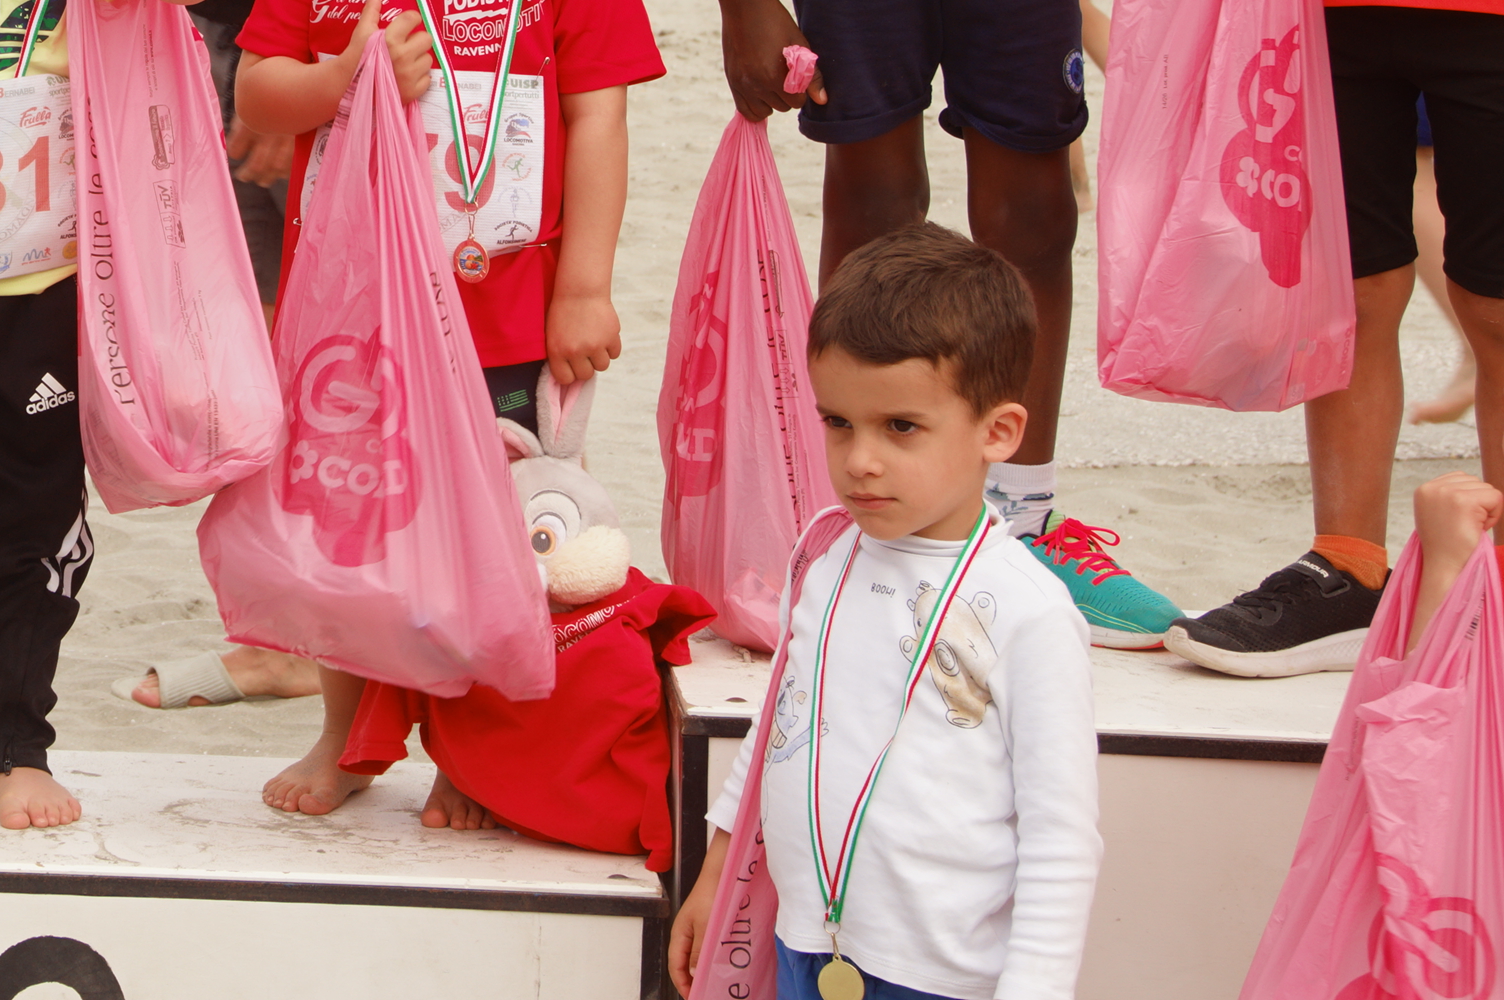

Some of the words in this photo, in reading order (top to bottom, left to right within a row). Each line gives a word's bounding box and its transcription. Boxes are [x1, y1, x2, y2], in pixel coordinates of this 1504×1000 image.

[453, 43, 503, 57] RAVENN
[510, 79, 539, 89] UISP
[91, 209, 115, 282] oltre
[25, 391, 76, 415] adidas
